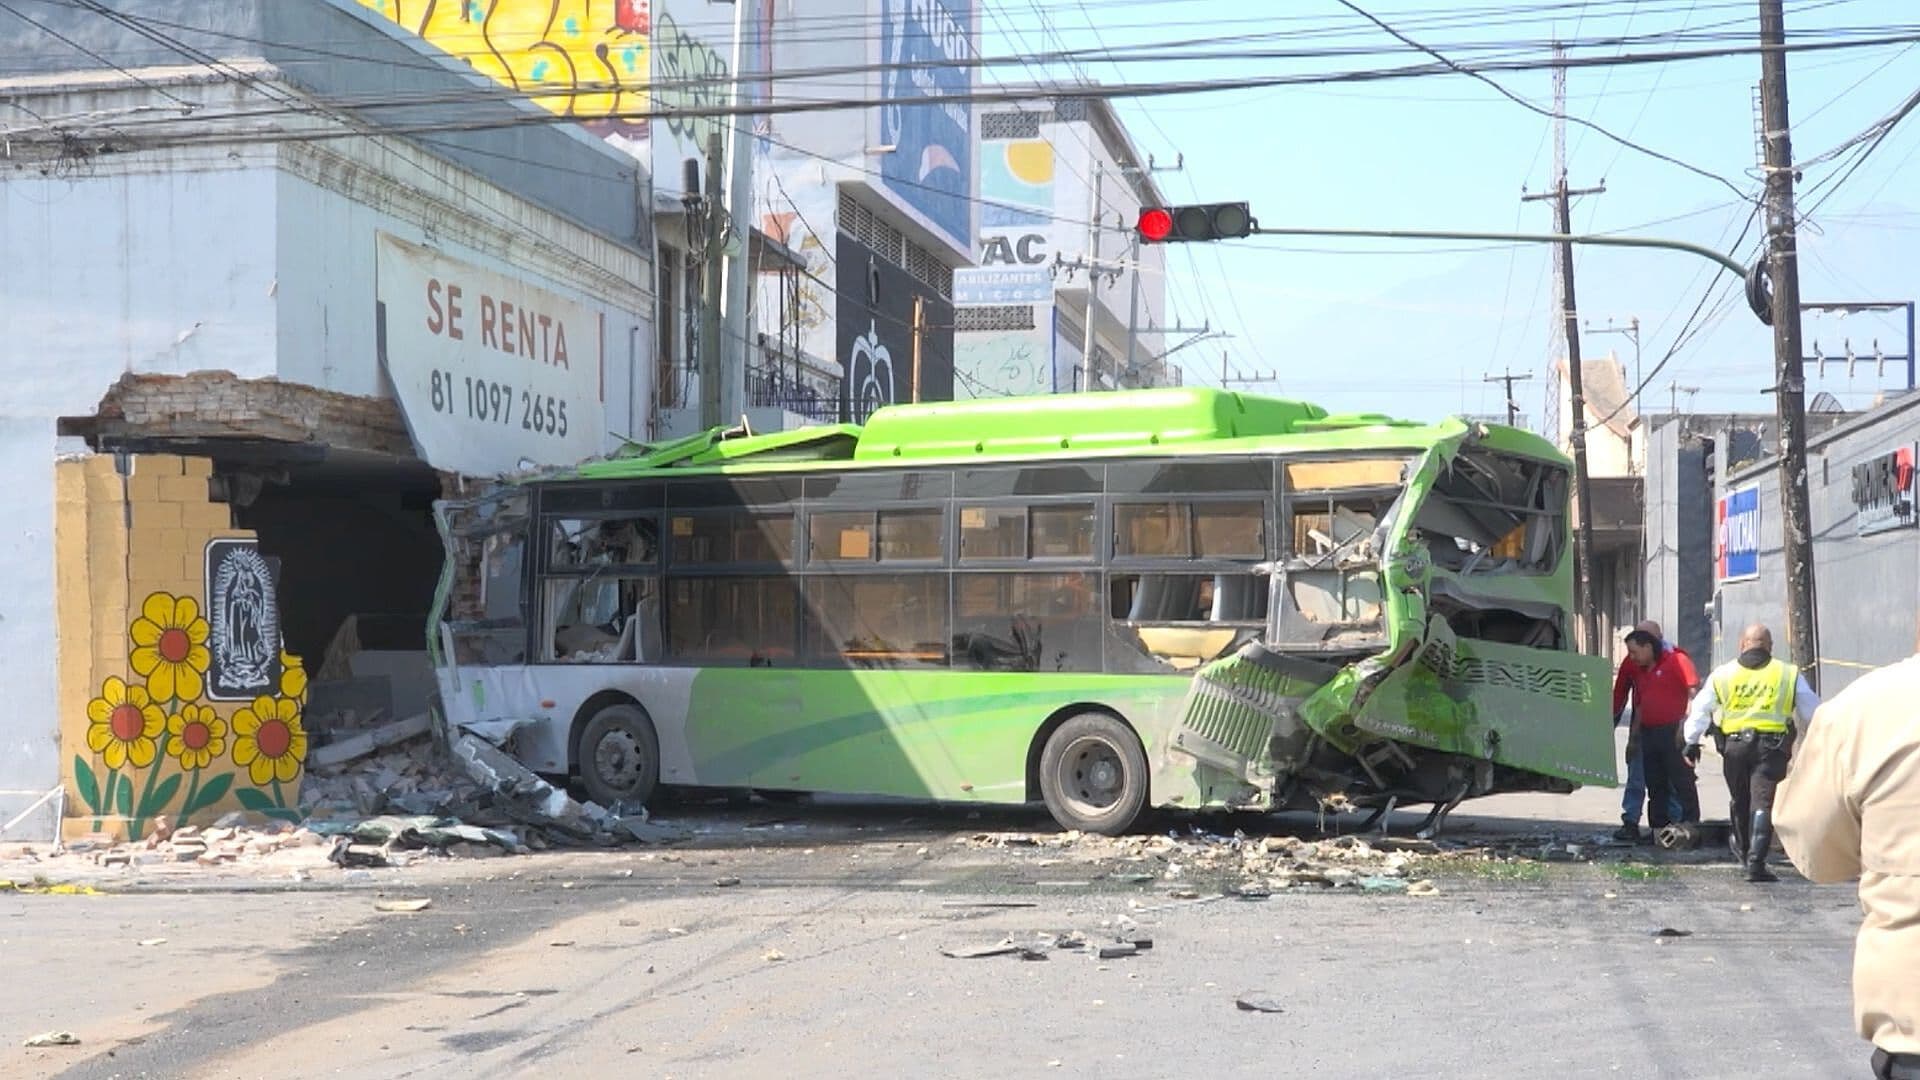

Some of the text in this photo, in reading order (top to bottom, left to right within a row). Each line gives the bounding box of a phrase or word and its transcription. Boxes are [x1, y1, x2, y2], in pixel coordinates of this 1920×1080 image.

[427, 278, 569, 371] SE RENTA
[431, 369, 568, 438] 81 1097 2655
